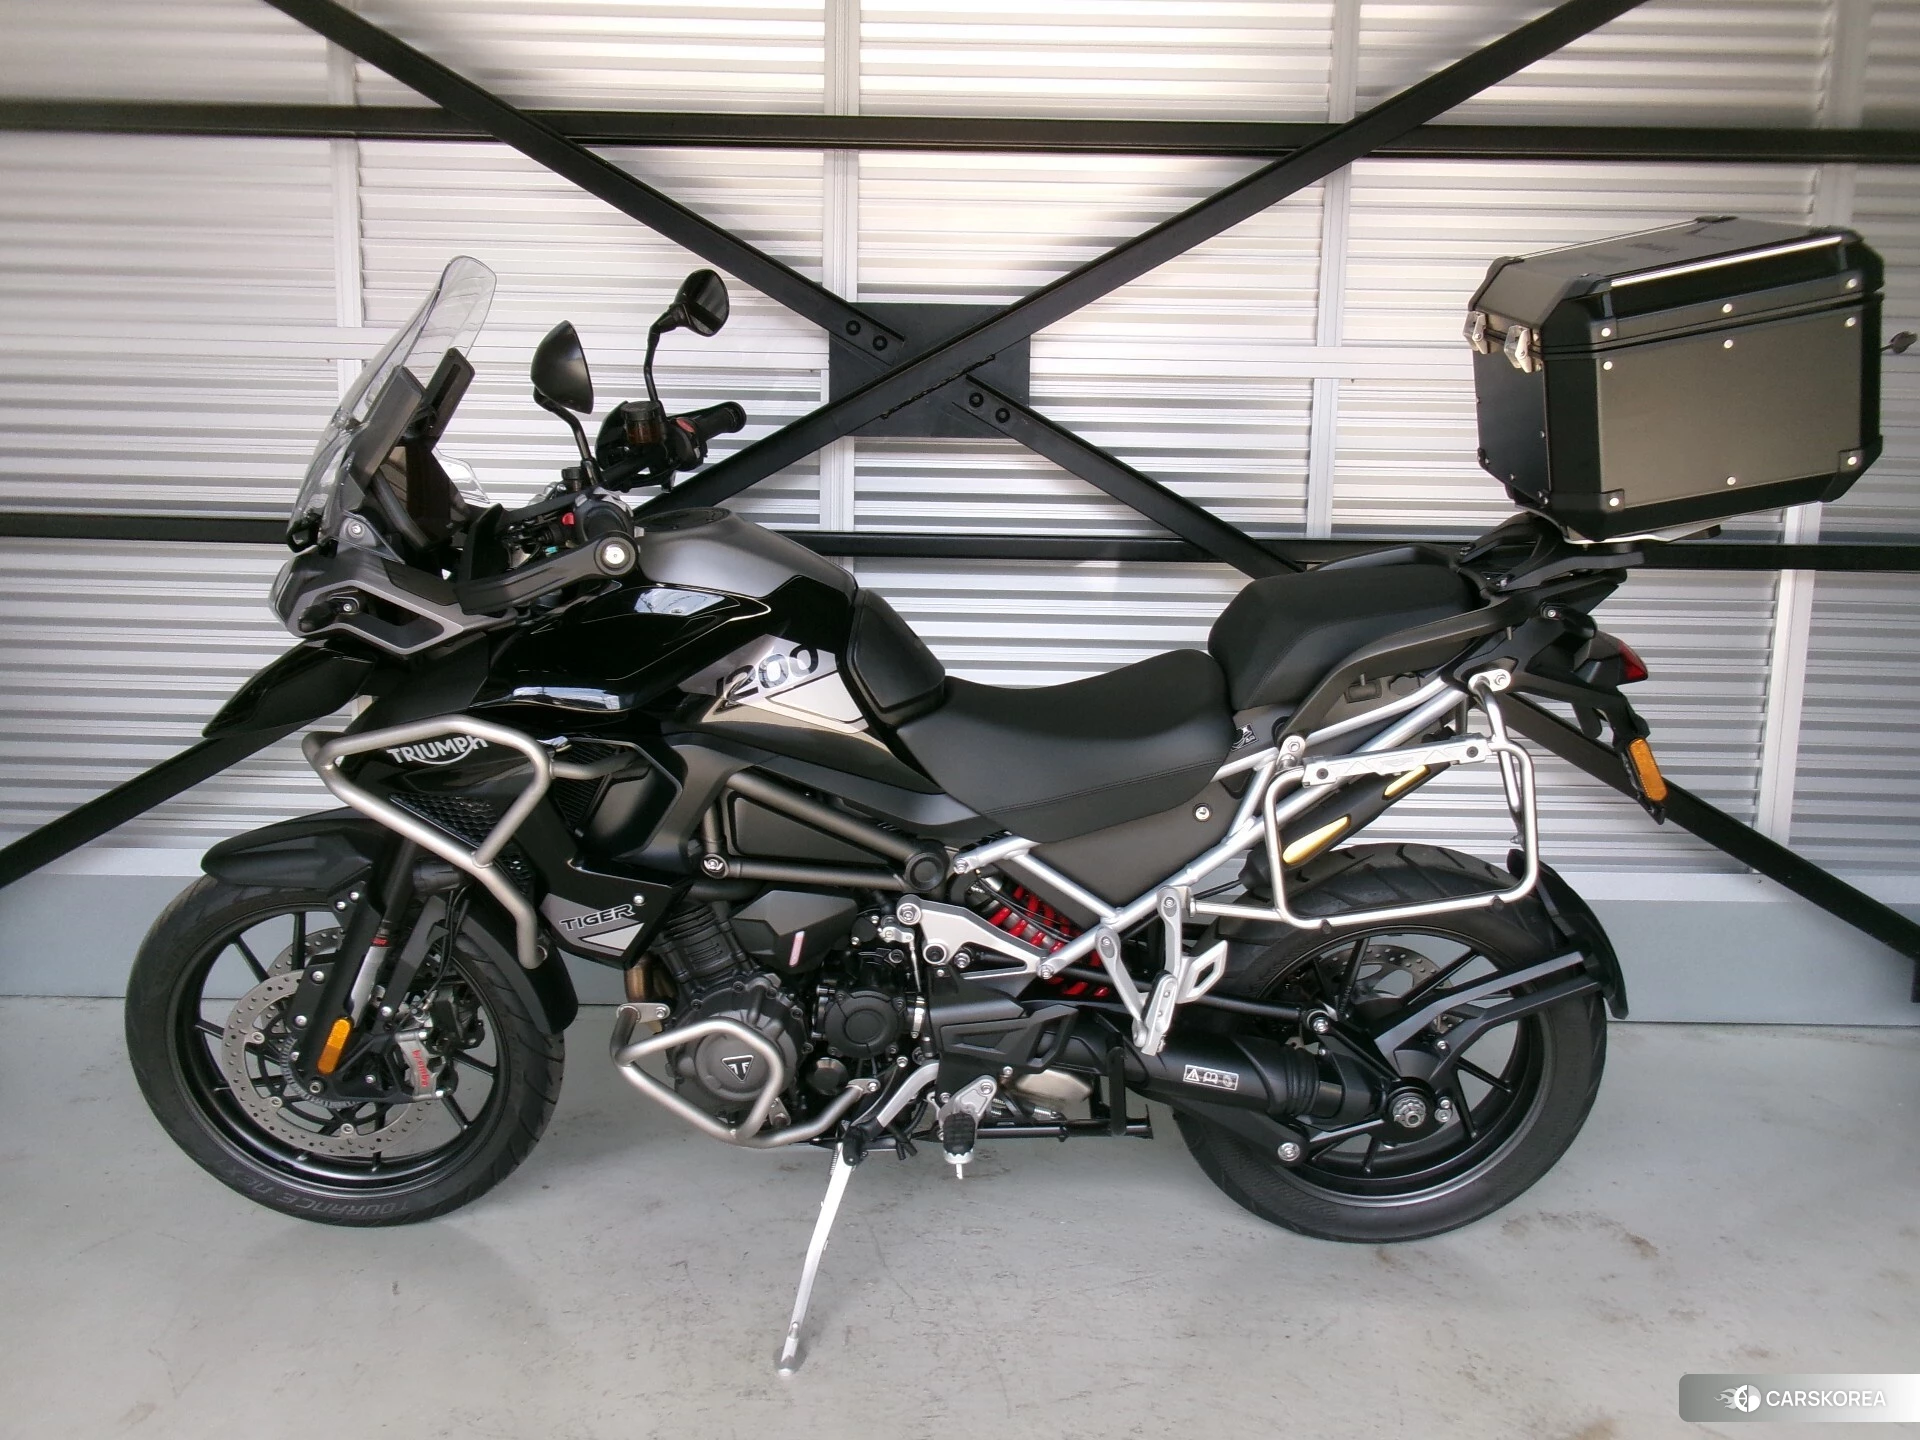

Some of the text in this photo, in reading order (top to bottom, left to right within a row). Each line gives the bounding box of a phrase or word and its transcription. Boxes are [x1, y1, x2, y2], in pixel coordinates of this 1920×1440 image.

[715, 644, 819, 712] 1200
[386, 735, 489, 764] TRIUMPH
[559, 903, 636, 931] TIGER
[276, 1193, 409, 1216] TOURANCE
